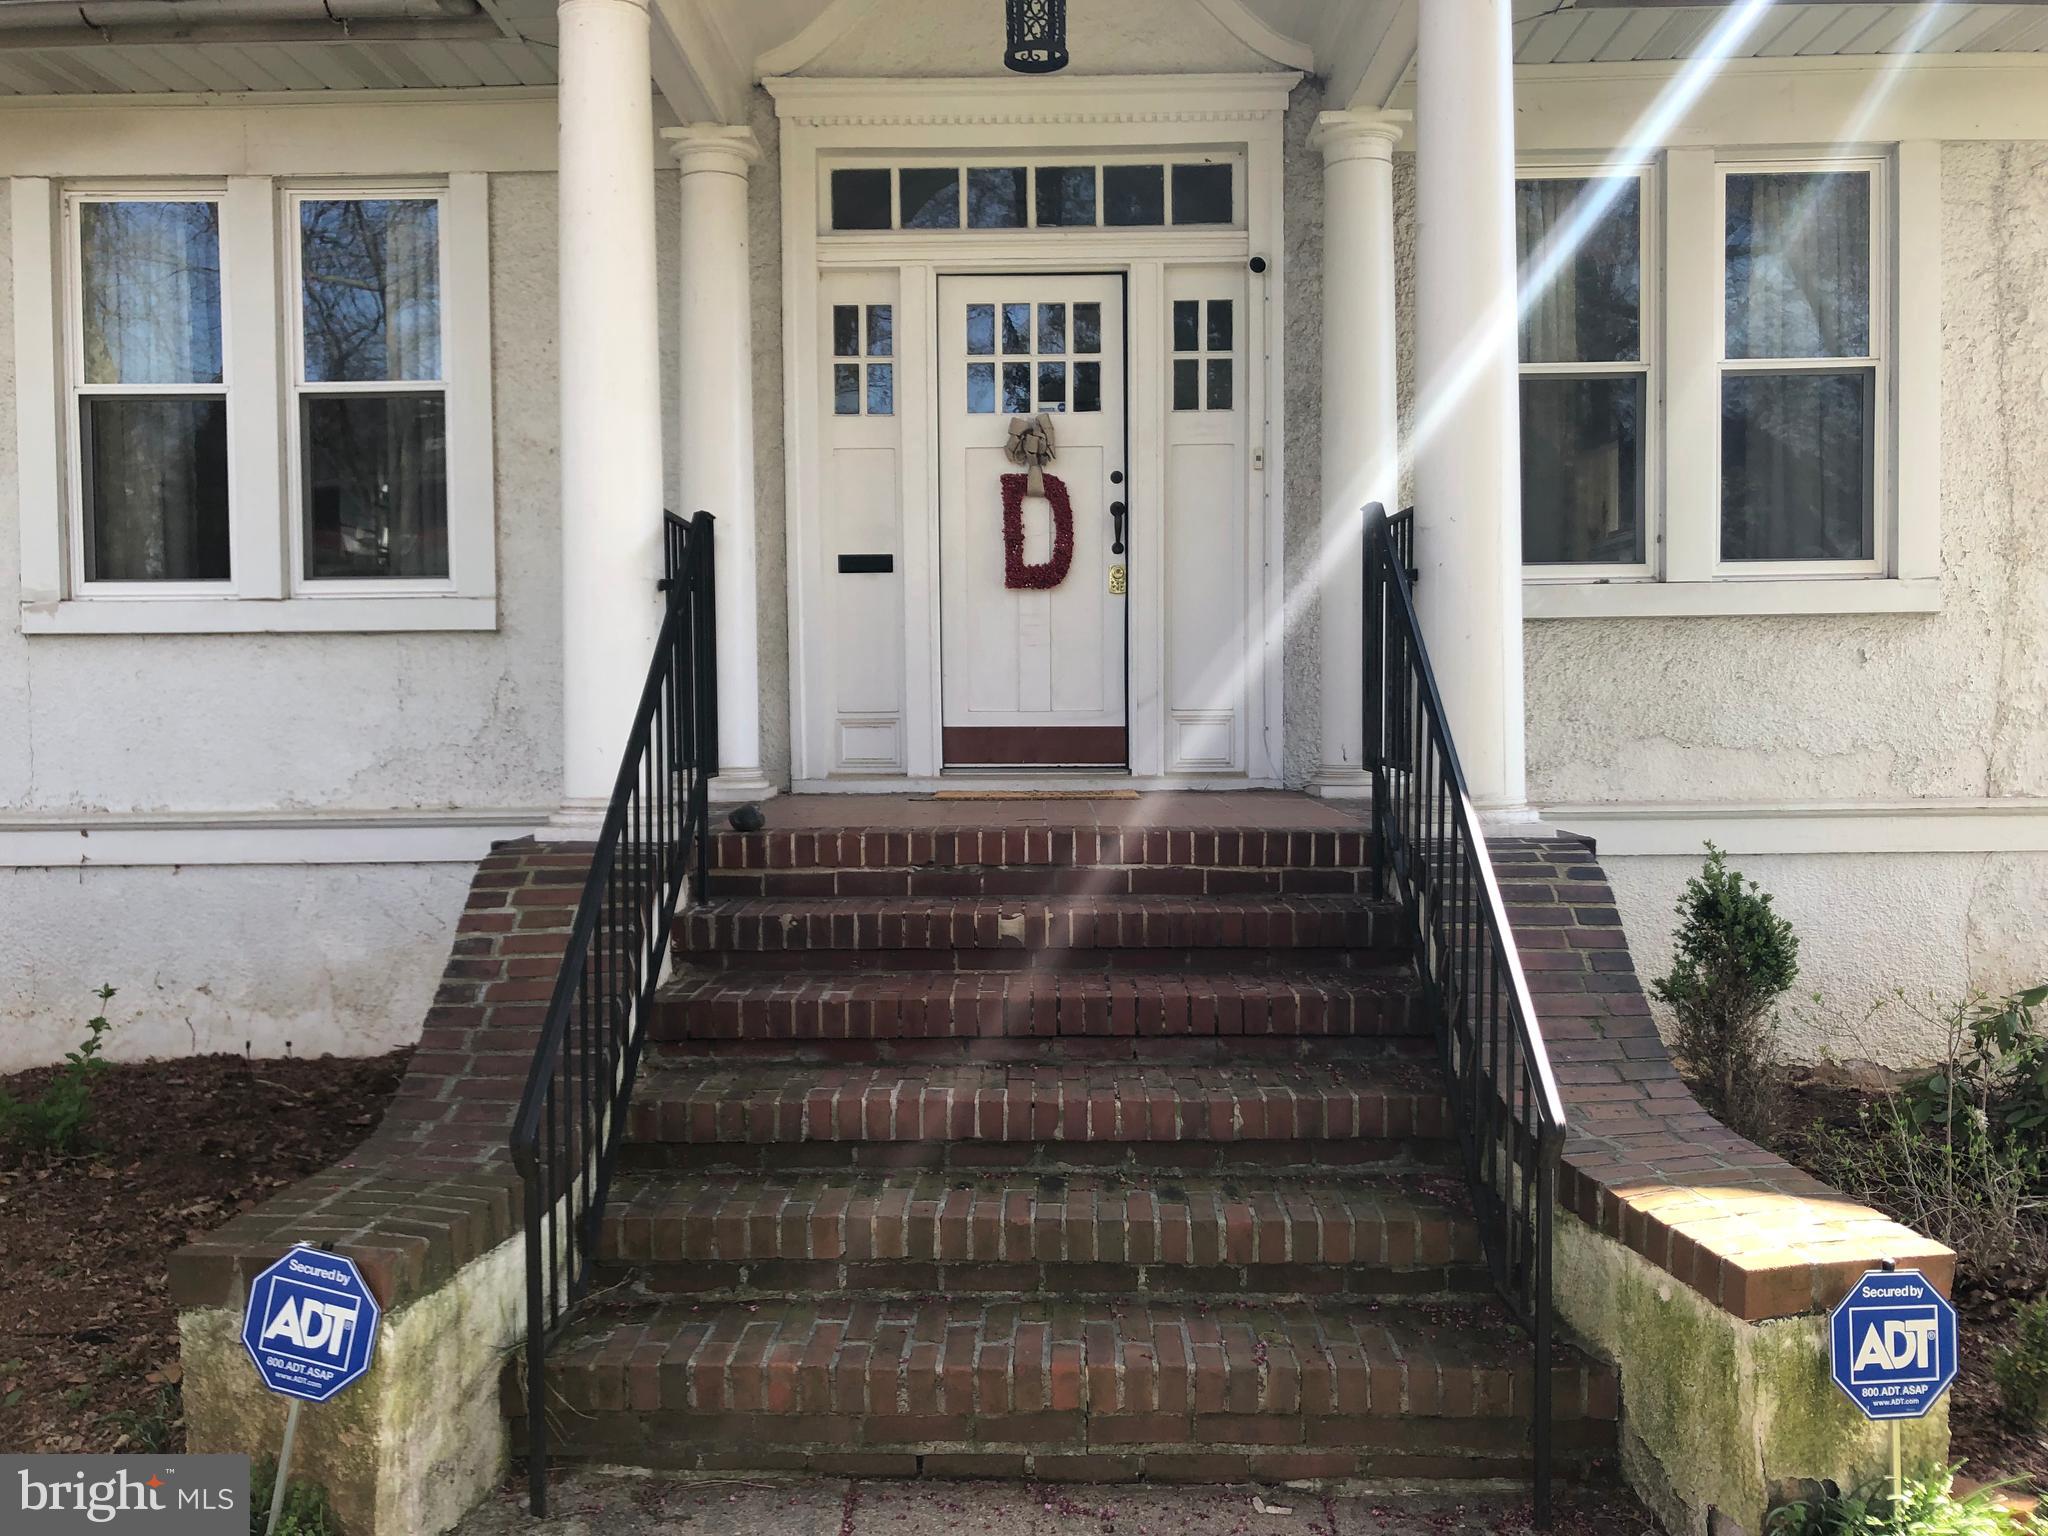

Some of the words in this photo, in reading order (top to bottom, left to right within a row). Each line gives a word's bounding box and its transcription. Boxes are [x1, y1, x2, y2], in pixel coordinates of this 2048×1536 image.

[1000, 473, 1074, 589] D
[288, 1258, 337, 1281] Secured
[337, 1270, 351, 1286] by
[1862, 1285, 1909, 1298] Secured
[1909, 1286, 1924, 1299] by
[1873, 1398, 1920, 1407] www.ADT.com
